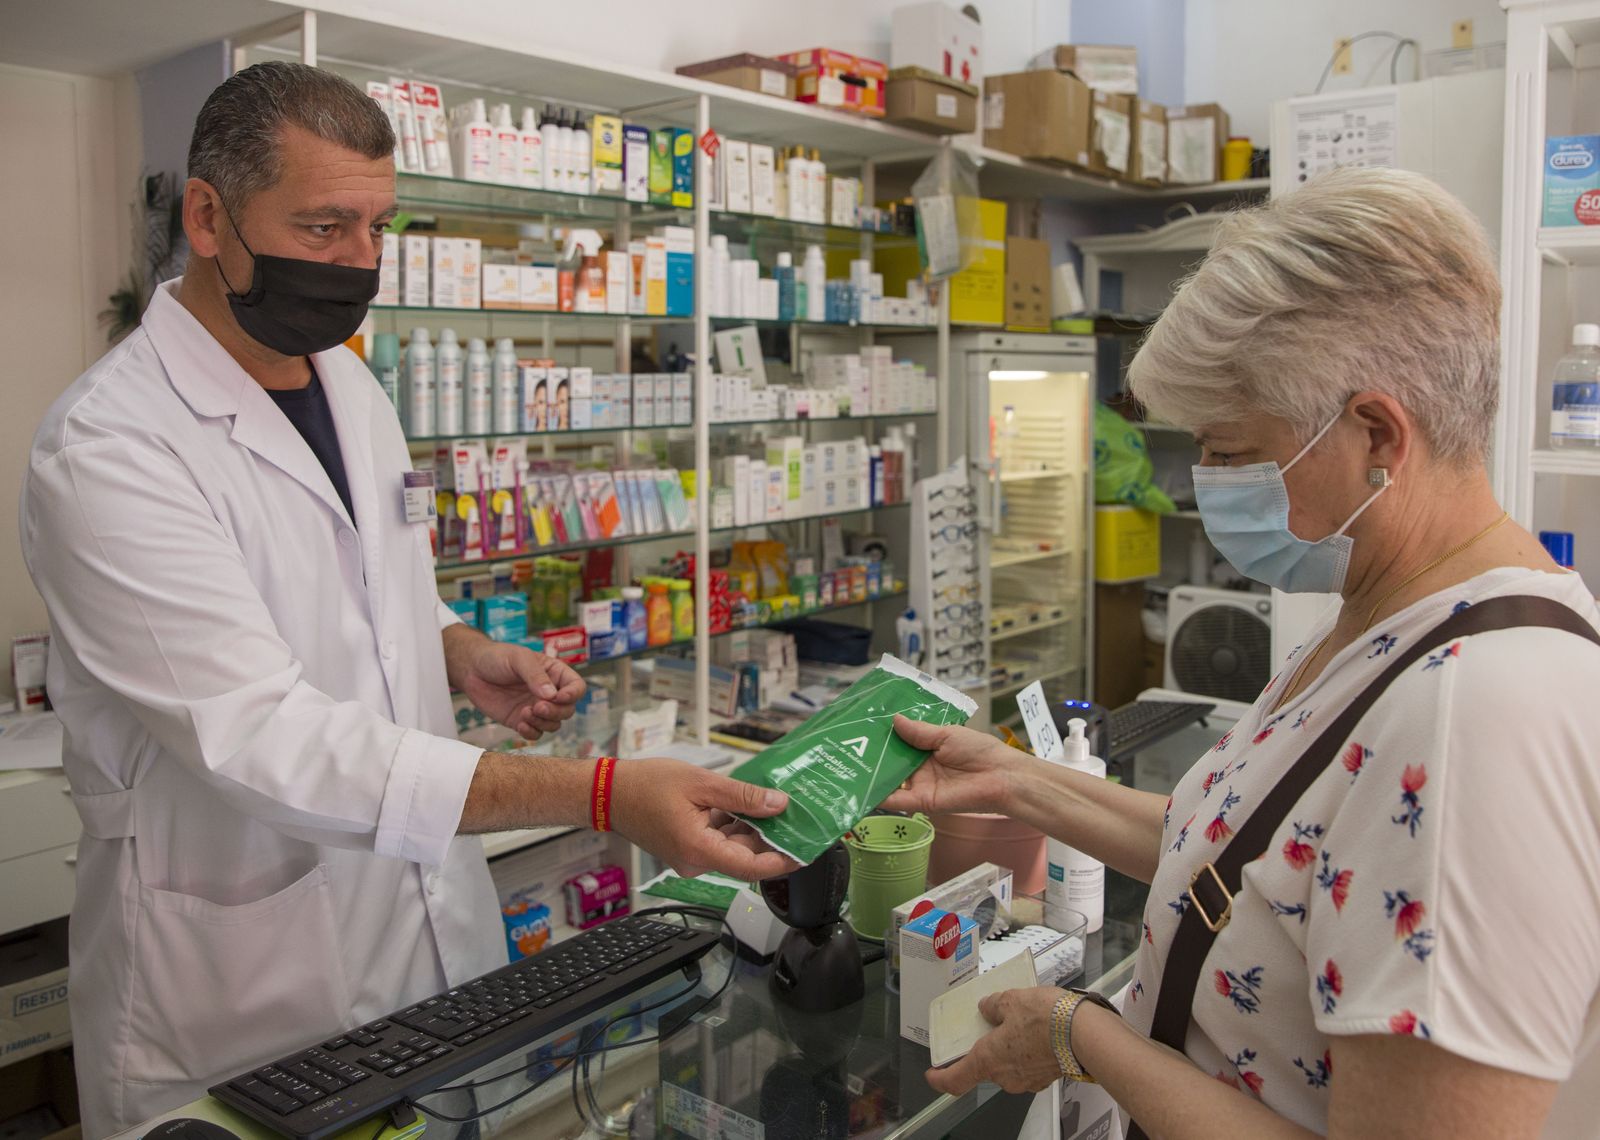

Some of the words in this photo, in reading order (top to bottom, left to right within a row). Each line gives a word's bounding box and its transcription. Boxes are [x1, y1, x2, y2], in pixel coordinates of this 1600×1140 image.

[1554, 154, 1588, 167] durex
[814, 744, 859, 778] Andalucía
[934, 921, 960, 950] OFERTA
